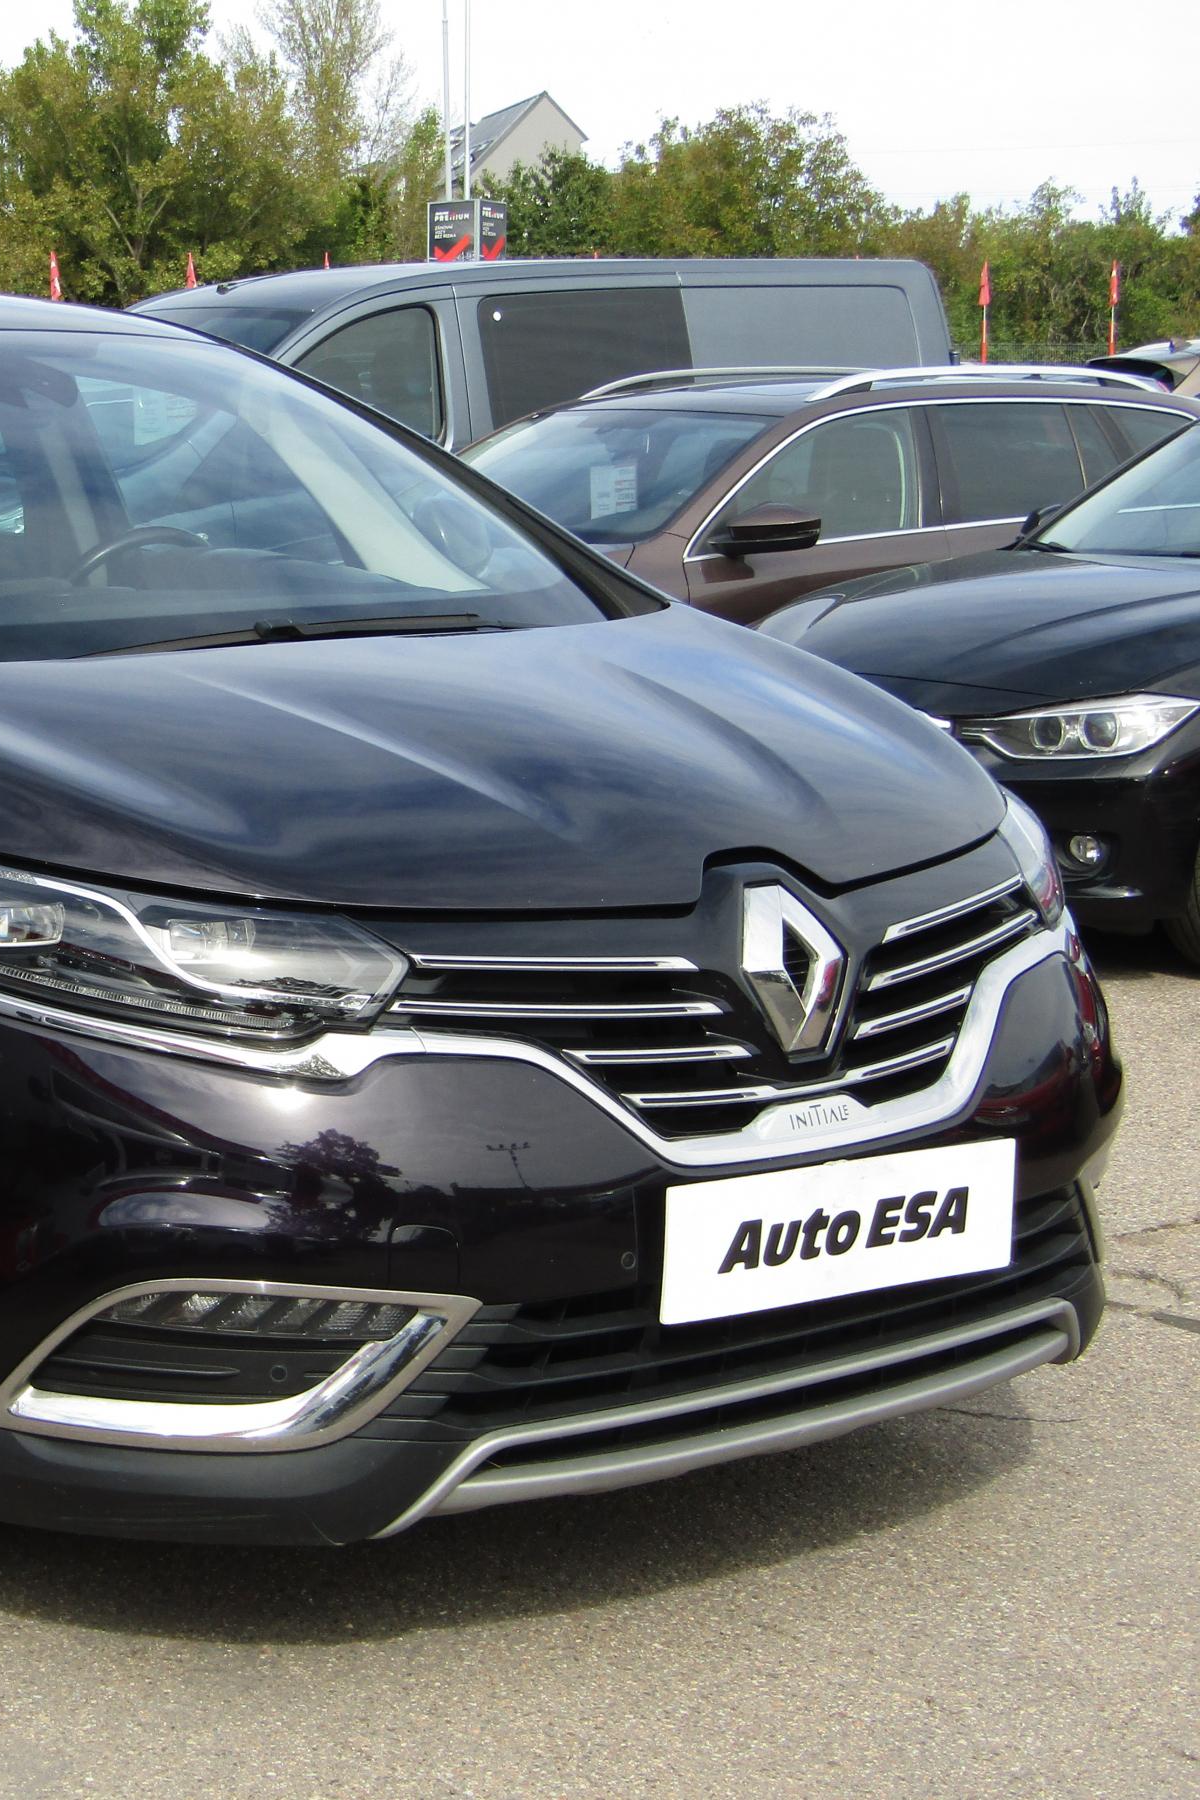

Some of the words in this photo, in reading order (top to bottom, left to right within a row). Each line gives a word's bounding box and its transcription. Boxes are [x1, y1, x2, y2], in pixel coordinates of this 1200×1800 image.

[789, 1104, 849, 1130] INITIALE
[717, 1207, 861, 1274] Auto
[865, 1186, 969, 1249] ESA
